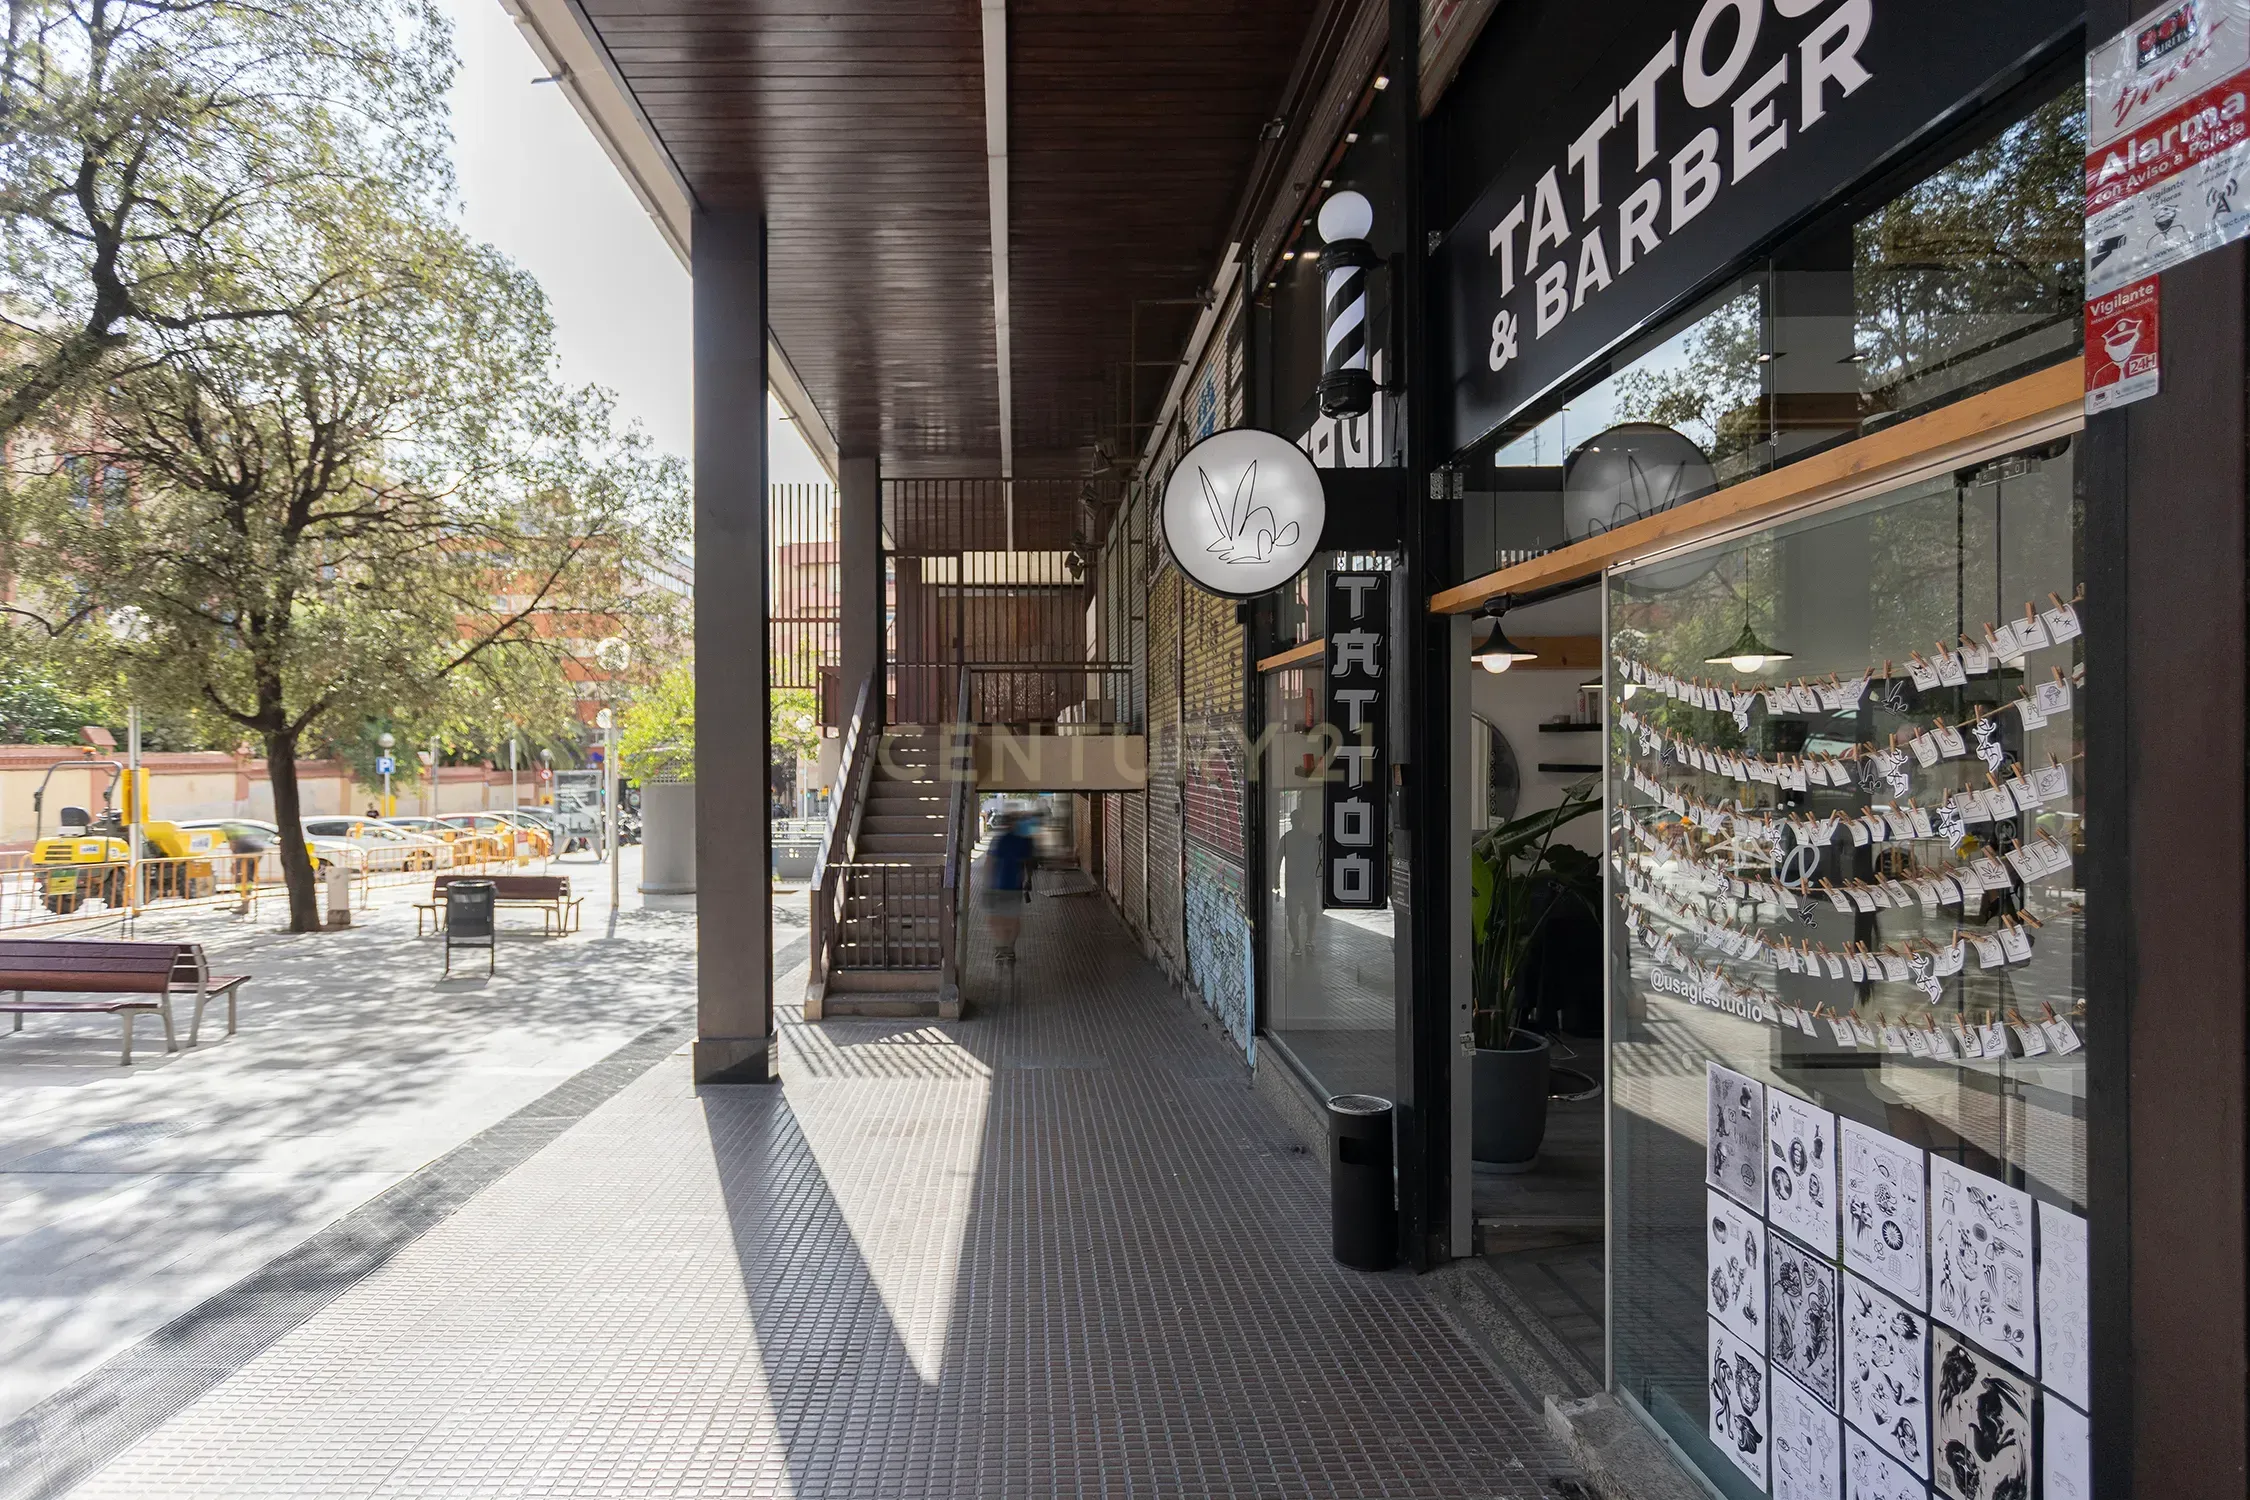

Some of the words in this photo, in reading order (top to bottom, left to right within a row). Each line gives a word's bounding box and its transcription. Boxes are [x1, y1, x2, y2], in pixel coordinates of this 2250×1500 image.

[1488, 309, 1519, 372] &
[1535, 0, 1874, 340] BARBER
[1489, 0, 1826, 299] TATTO
[2094, 184, 2122, 205] con
[2127, 160, 2169, 192] Aviso
[2173, 154, 2184, 167] a
[2096, 92, 2246, 188] Alarma
[2089, 284, 2155, 317] Vigilante
[2130, 353, 2155, 374] 24H
[1331, 576, 1383, 903] TATTOO
